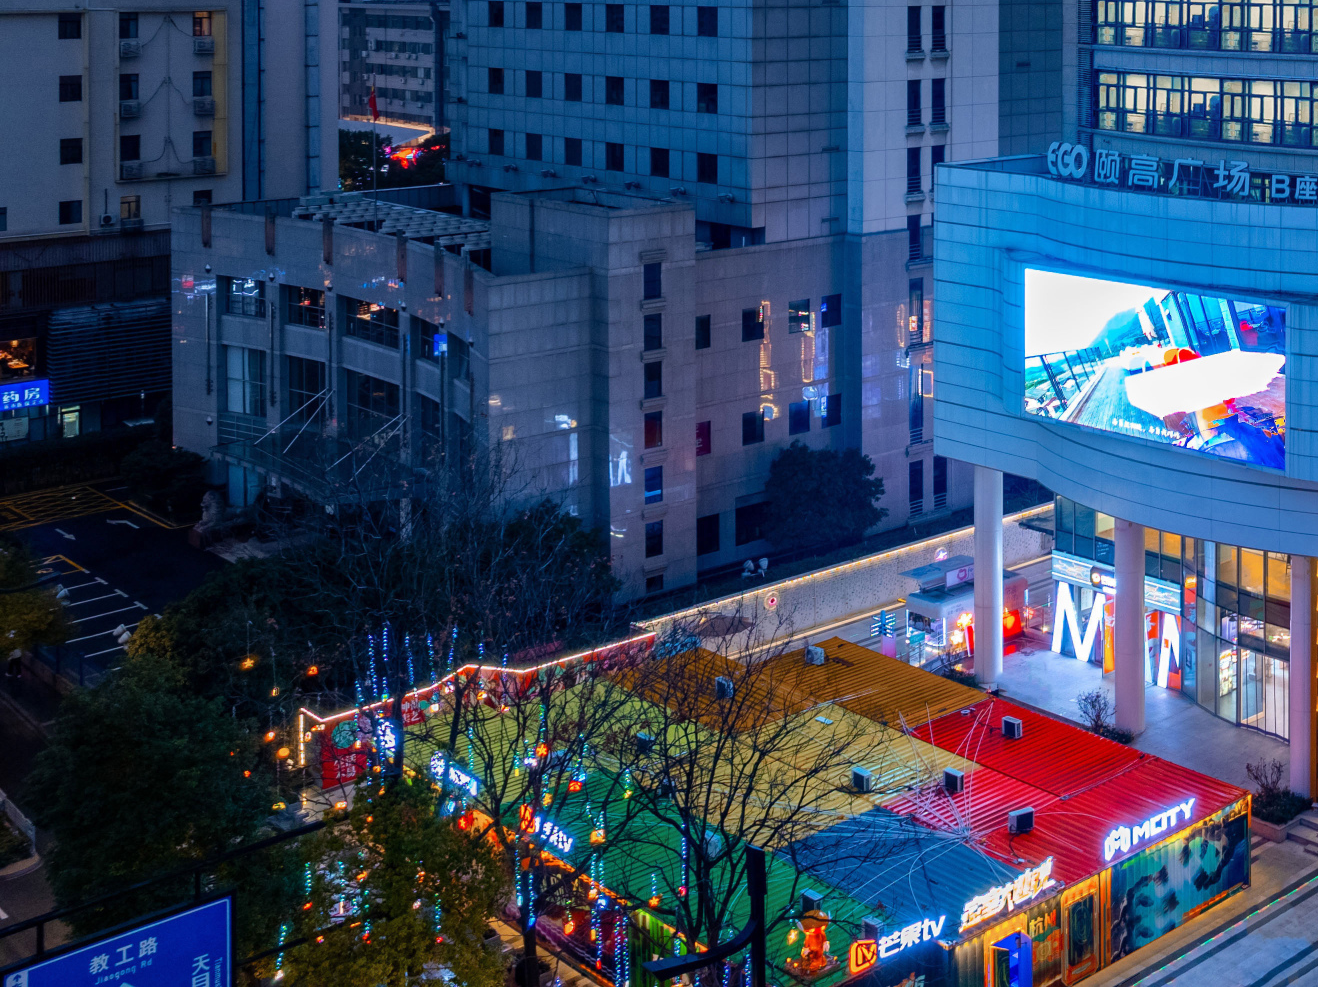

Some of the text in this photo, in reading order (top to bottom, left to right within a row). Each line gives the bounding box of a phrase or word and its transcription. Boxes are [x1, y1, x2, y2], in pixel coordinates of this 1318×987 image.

[1047, 141, 1318, 201] EGO 颐高广场 B座
[1, 387, 40, 404] 药房
[1132, 797, 1196, 845] MCITY
[89, 936, 158, 975] 教工路
[94, 958, 153, 985] Jiaogong Rd
